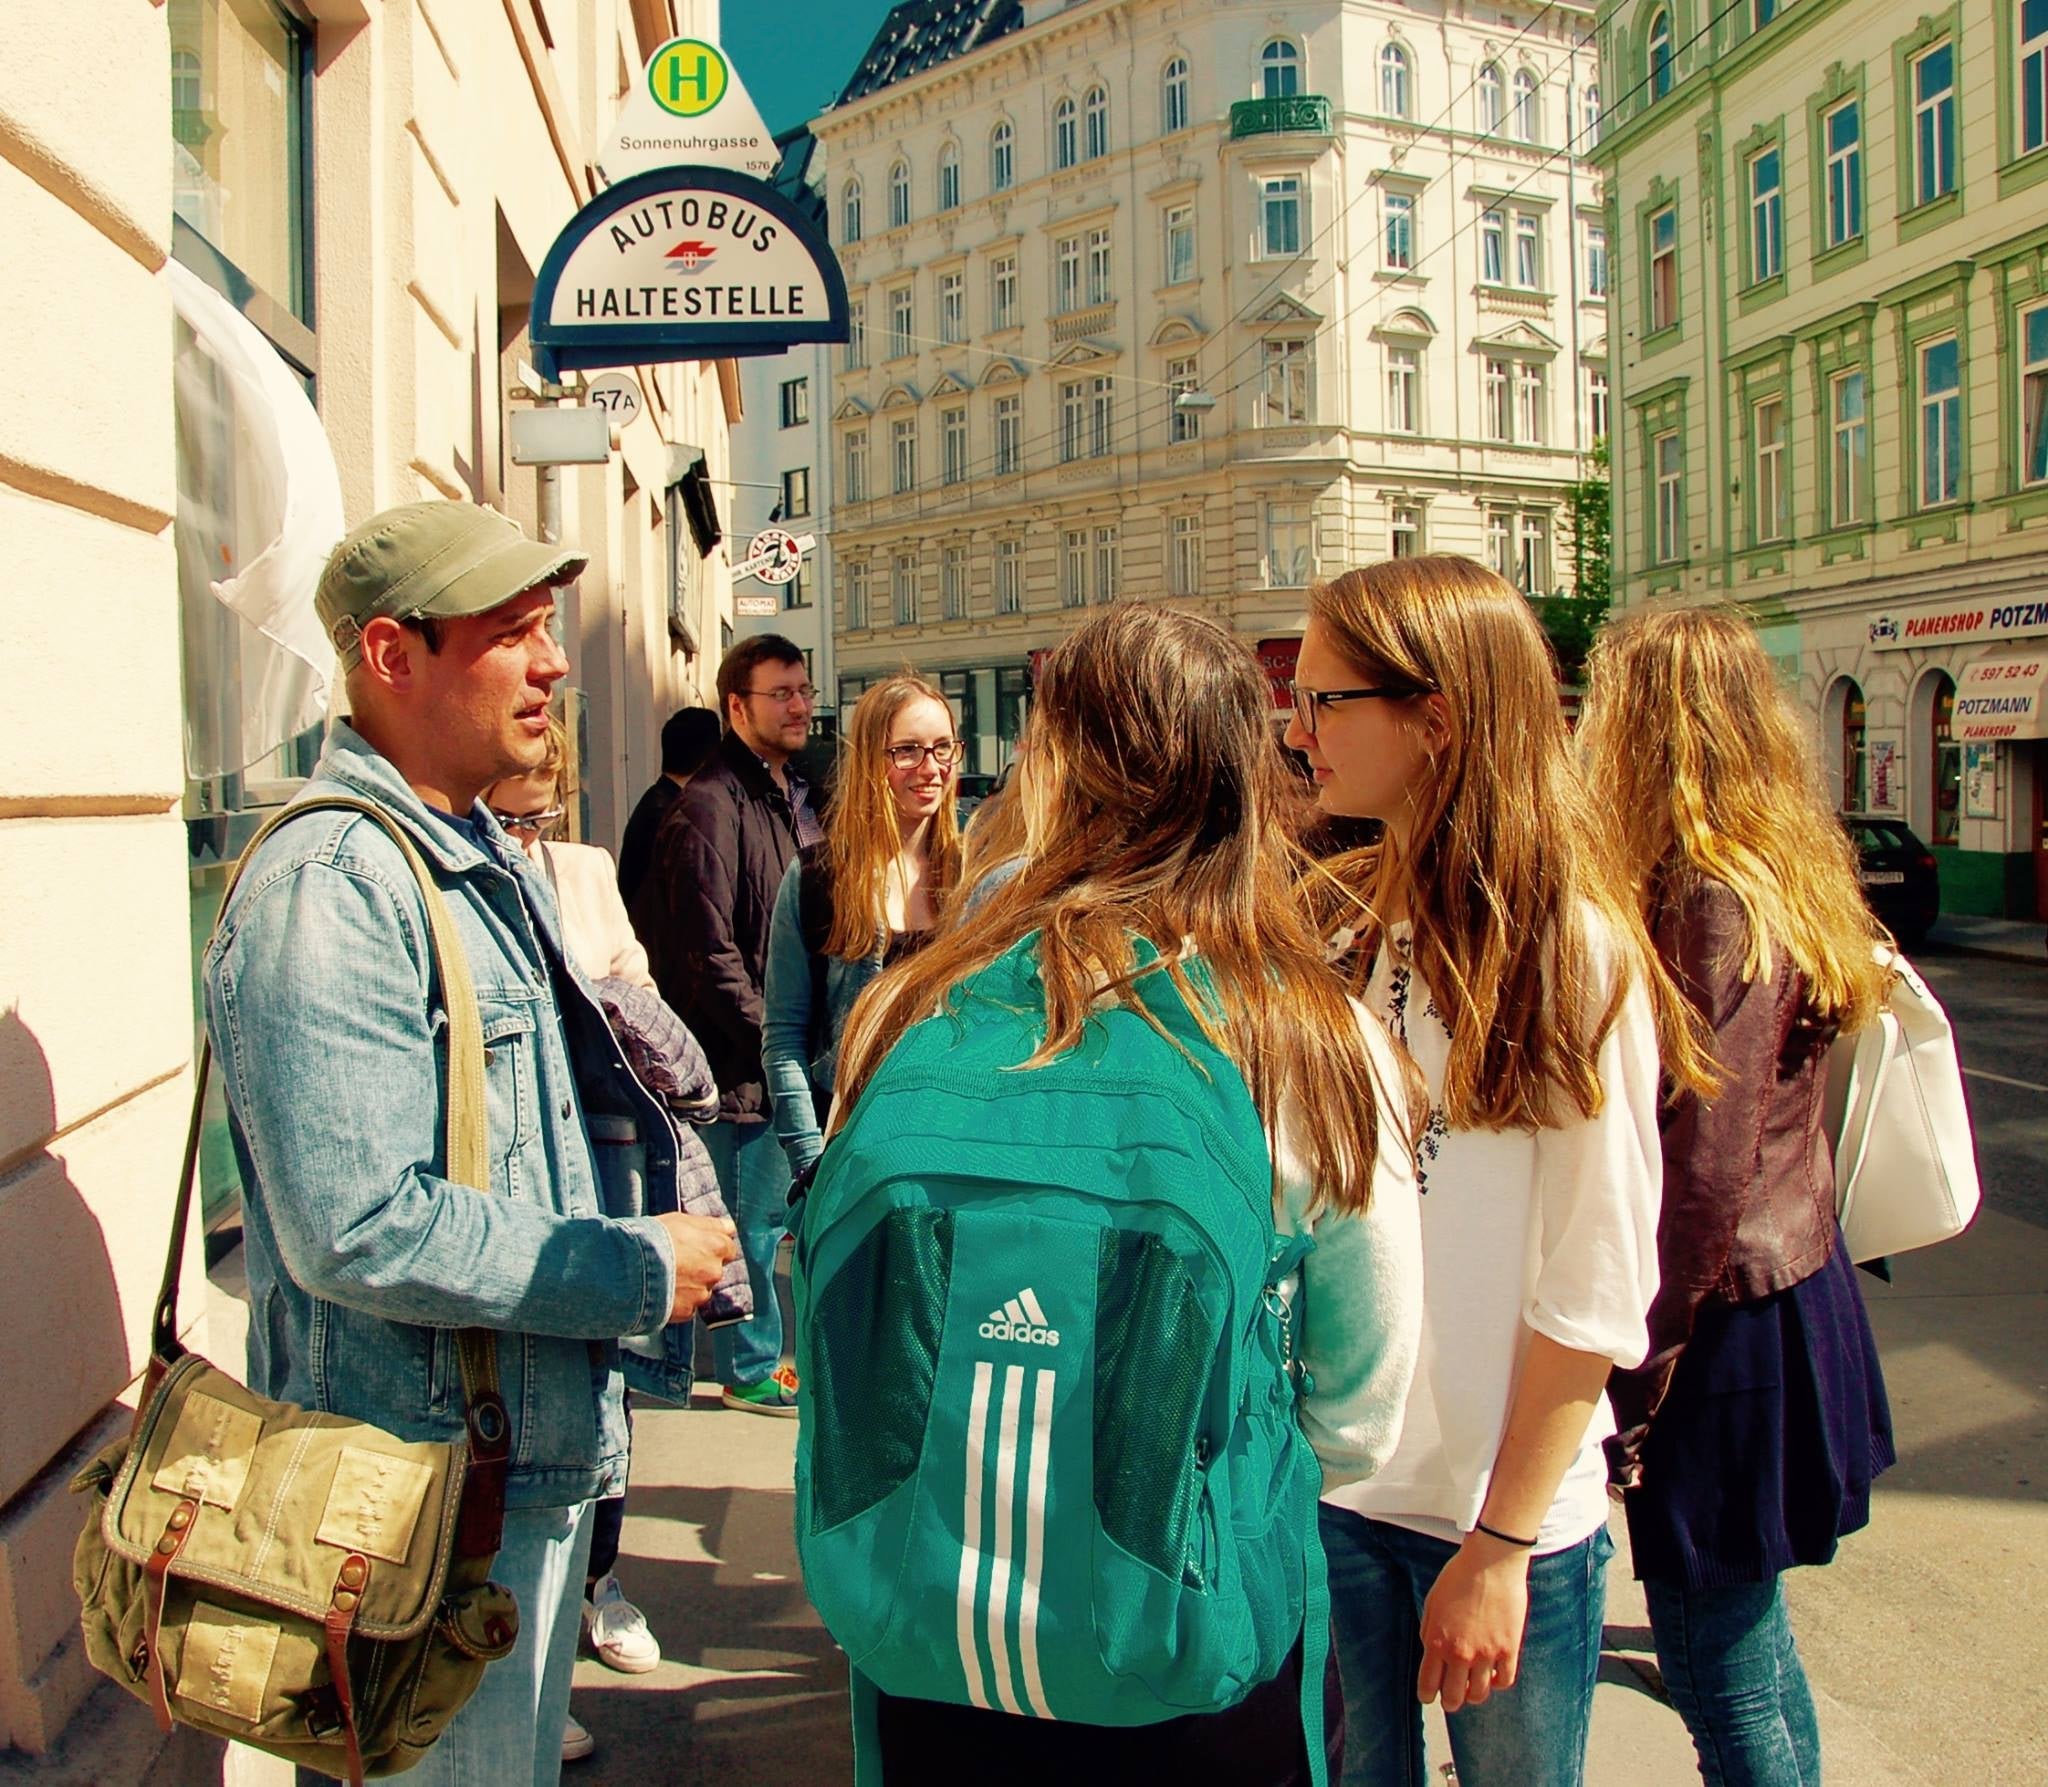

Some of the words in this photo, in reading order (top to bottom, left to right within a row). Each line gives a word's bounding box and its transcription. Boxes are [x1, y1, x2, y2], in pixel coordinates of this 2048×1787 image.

[669, 55, 708, 102] H
[620, 136, 759, 151] Sonnenuhrgasse
[746, 161, 770, 171] 1576
[609, 198, 777, 254] AUTOBUS
[577, 285, 804, 317] HALTESTELLE
[1905, 611, 1984, 637] PLANENSHOP
[1980, 667, 2003, 680] 597
[2005, 665, 2021, 679] 52
[2022, 664, 2039, 677] 43
[1957, 697, 2032, 715] POTZMANN
[1964, 725, 2016, 737] PLANENSHOP
[979, 1321, 1060, 1347] adidas
